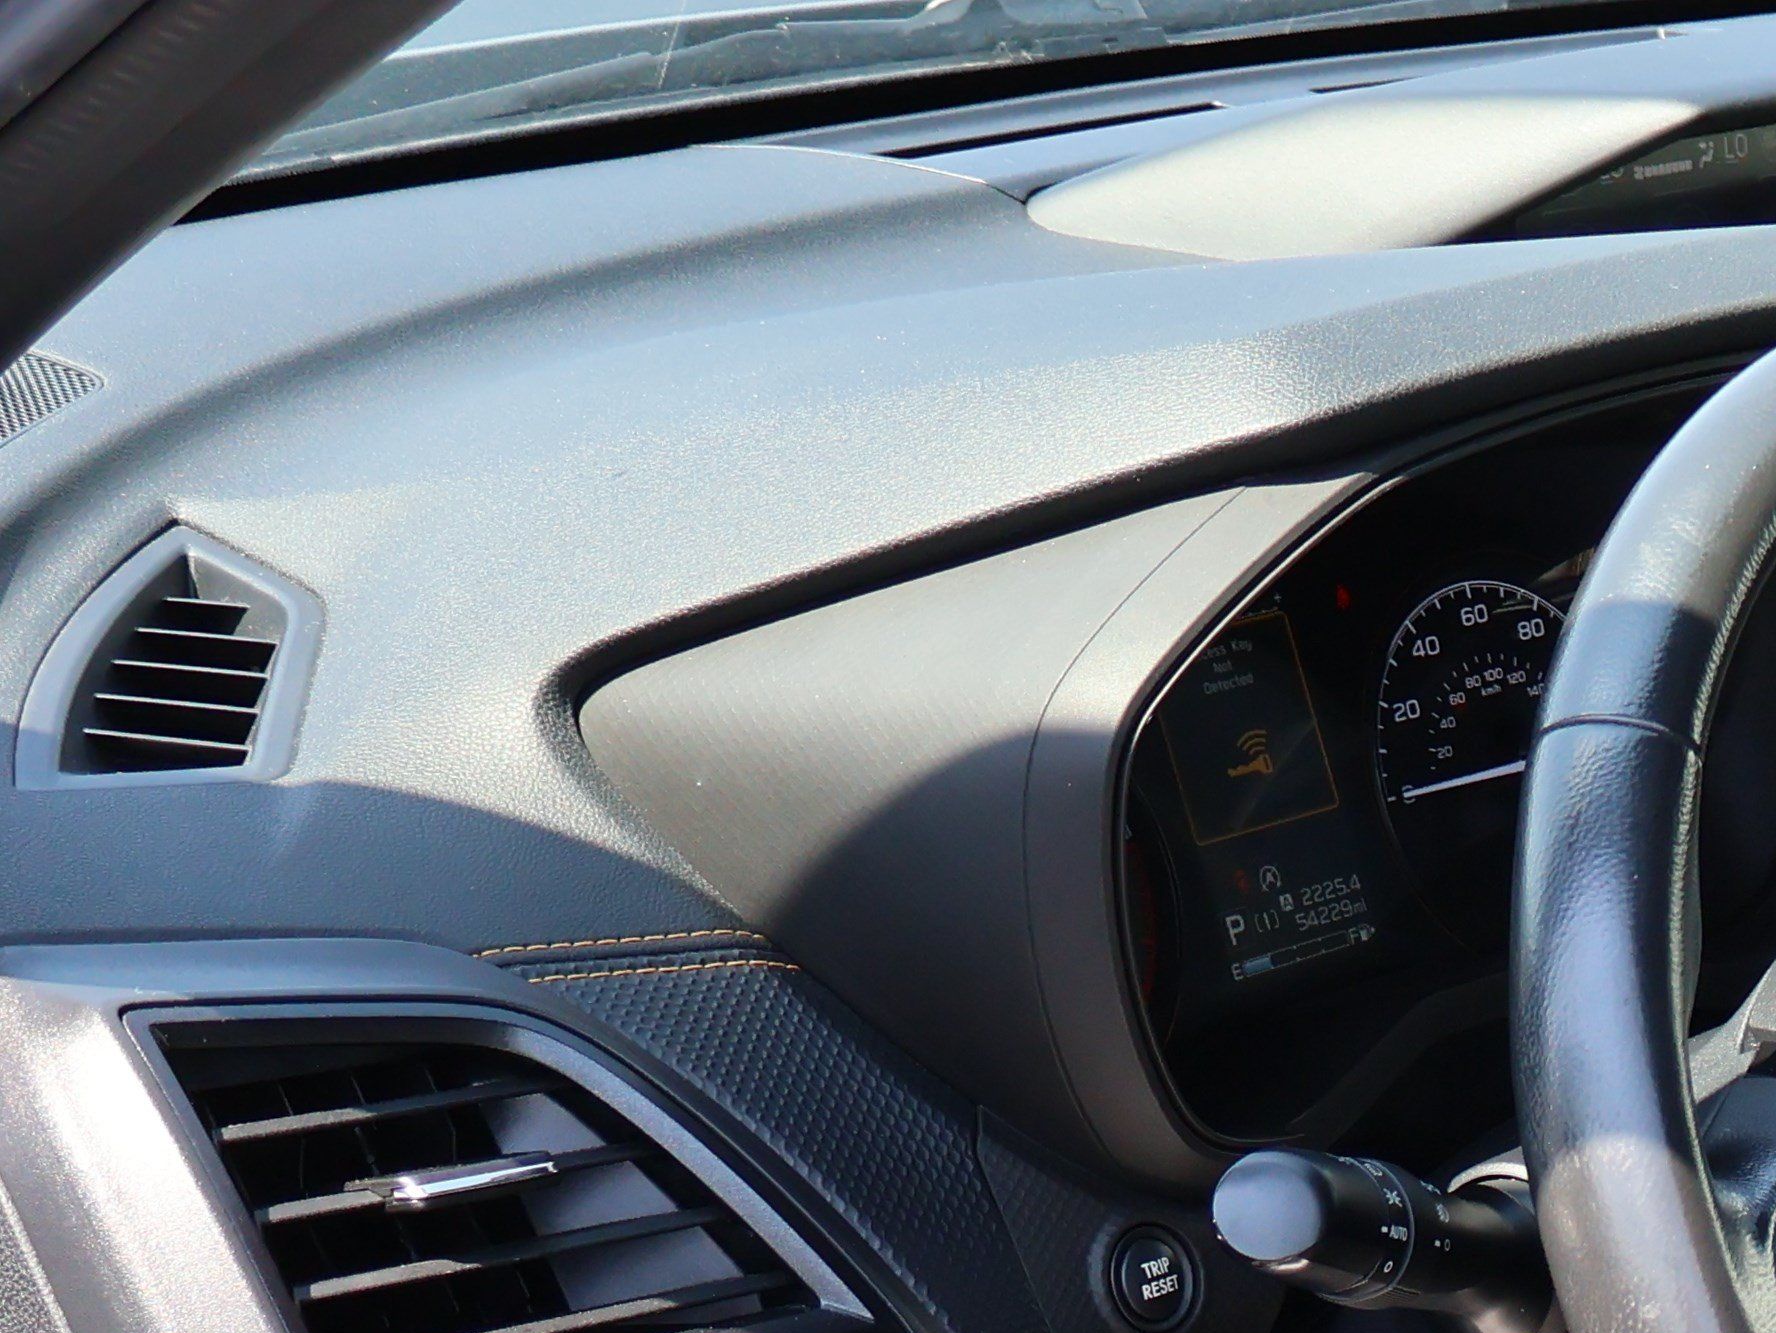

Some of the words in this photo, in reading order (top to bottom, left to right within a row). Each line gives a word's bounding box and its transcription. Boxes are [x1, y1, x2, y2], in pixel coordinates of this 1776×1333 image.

[1460, 603, 1489, 627] 60
[1516, 618, 1545, 641] 80
[1412, 635, 1440, 658] 40
[1202, 673, 1254, 694] Detected
[1464, 675, 1481, 689] 80
[1483, 667, 1504, 682] 100
[1506, 670, 1527, 685] 120
[1449, 692, 1466, 706] 60
[1392, 699, 1421, 723] 20
[1439, 716, 1457, 729] 40
[1437, 745, 1453, 759] 20
[1300, 874, 1361, 906] 2225.4
[1225, 914, 1245, 946] P
[1389, 1224, 1408, 1242] AUTO
[1141, 1256, 1170, 1280] TRIP
[1142, 1274, 1180, 1301] RESET
